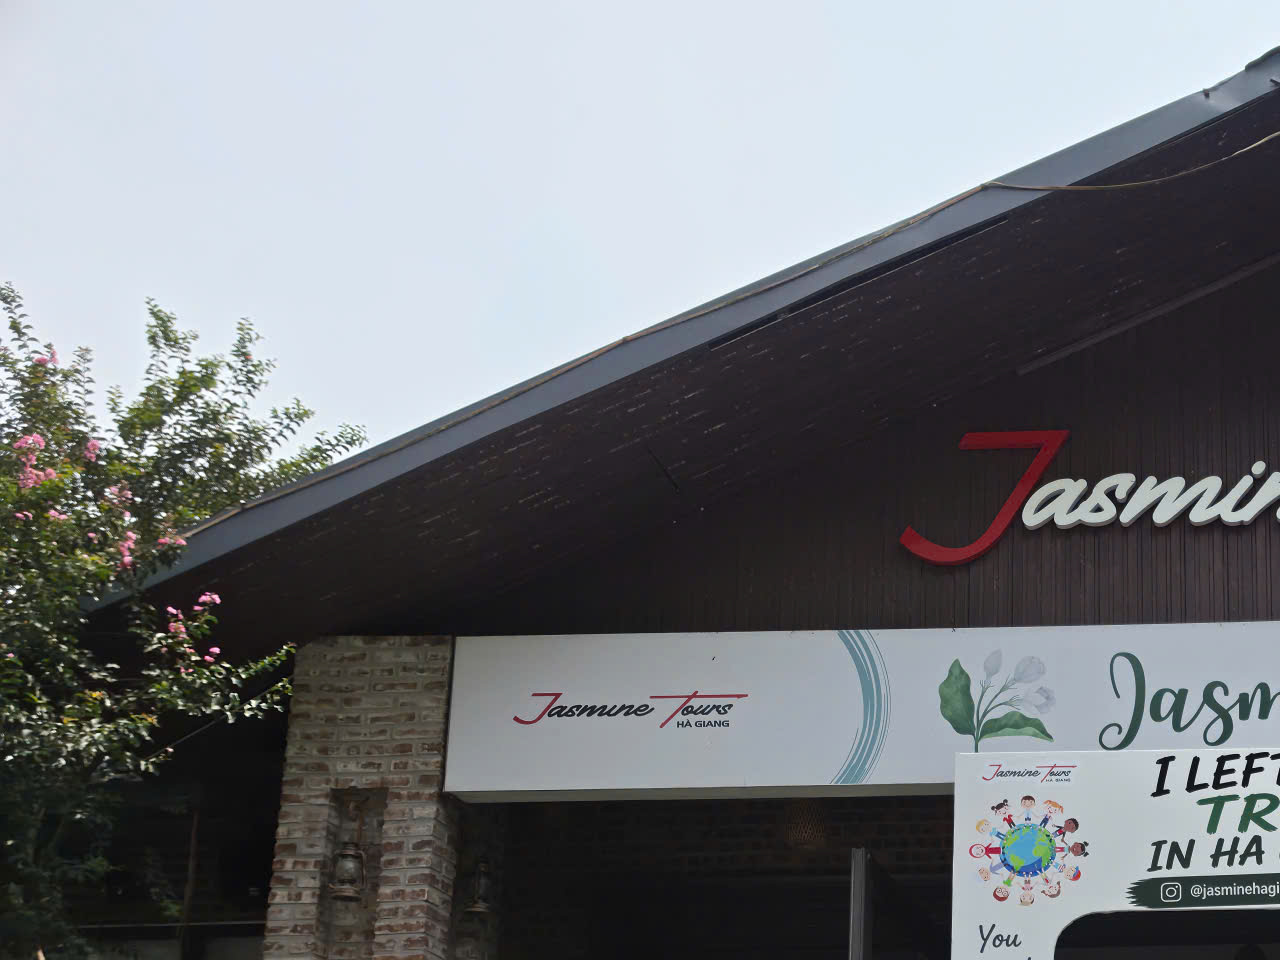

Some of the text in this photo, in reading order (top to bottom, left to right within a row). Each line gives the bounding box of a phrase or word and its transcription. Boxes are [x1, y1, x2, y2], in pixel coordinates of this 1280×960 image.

[513, 690, 749, 729] Jasmine Tours
[677, 718, 730, 728] HÀ GIANG
[982, 763, 1078, 783] Jasmine Tours
[1150, 755, 1176, 798] I
[1146, 839, 1196, 873] IN
[1209, 834, 1267, 868] HA
[978, 923, 1022, 955] You
